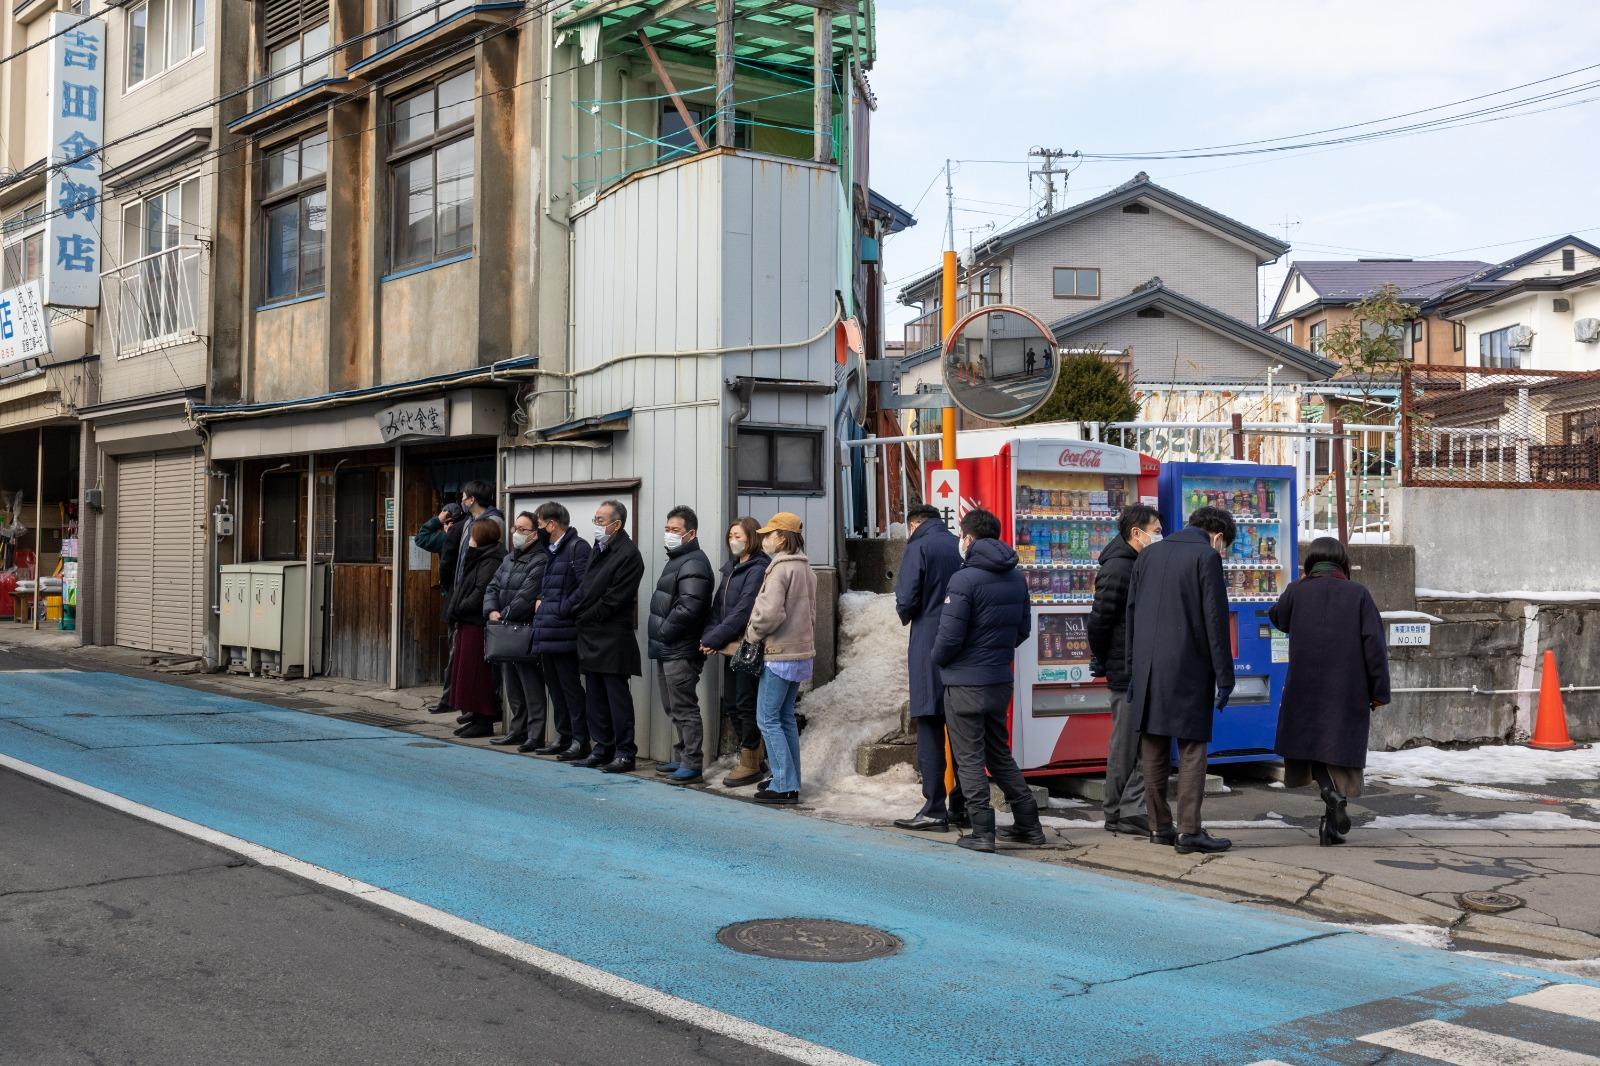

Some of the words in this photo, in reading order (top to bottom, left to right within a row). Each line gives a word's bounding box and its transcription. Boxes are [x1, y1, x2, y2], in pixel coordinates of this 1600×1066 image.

[56, 30, 100, 273] 吉田金物店
[386, 406, 439, 435] みなと食堂
[1059, 447, 1103, 468] Coca-Cola
[1398, 636, 1422, 644] NO.10
